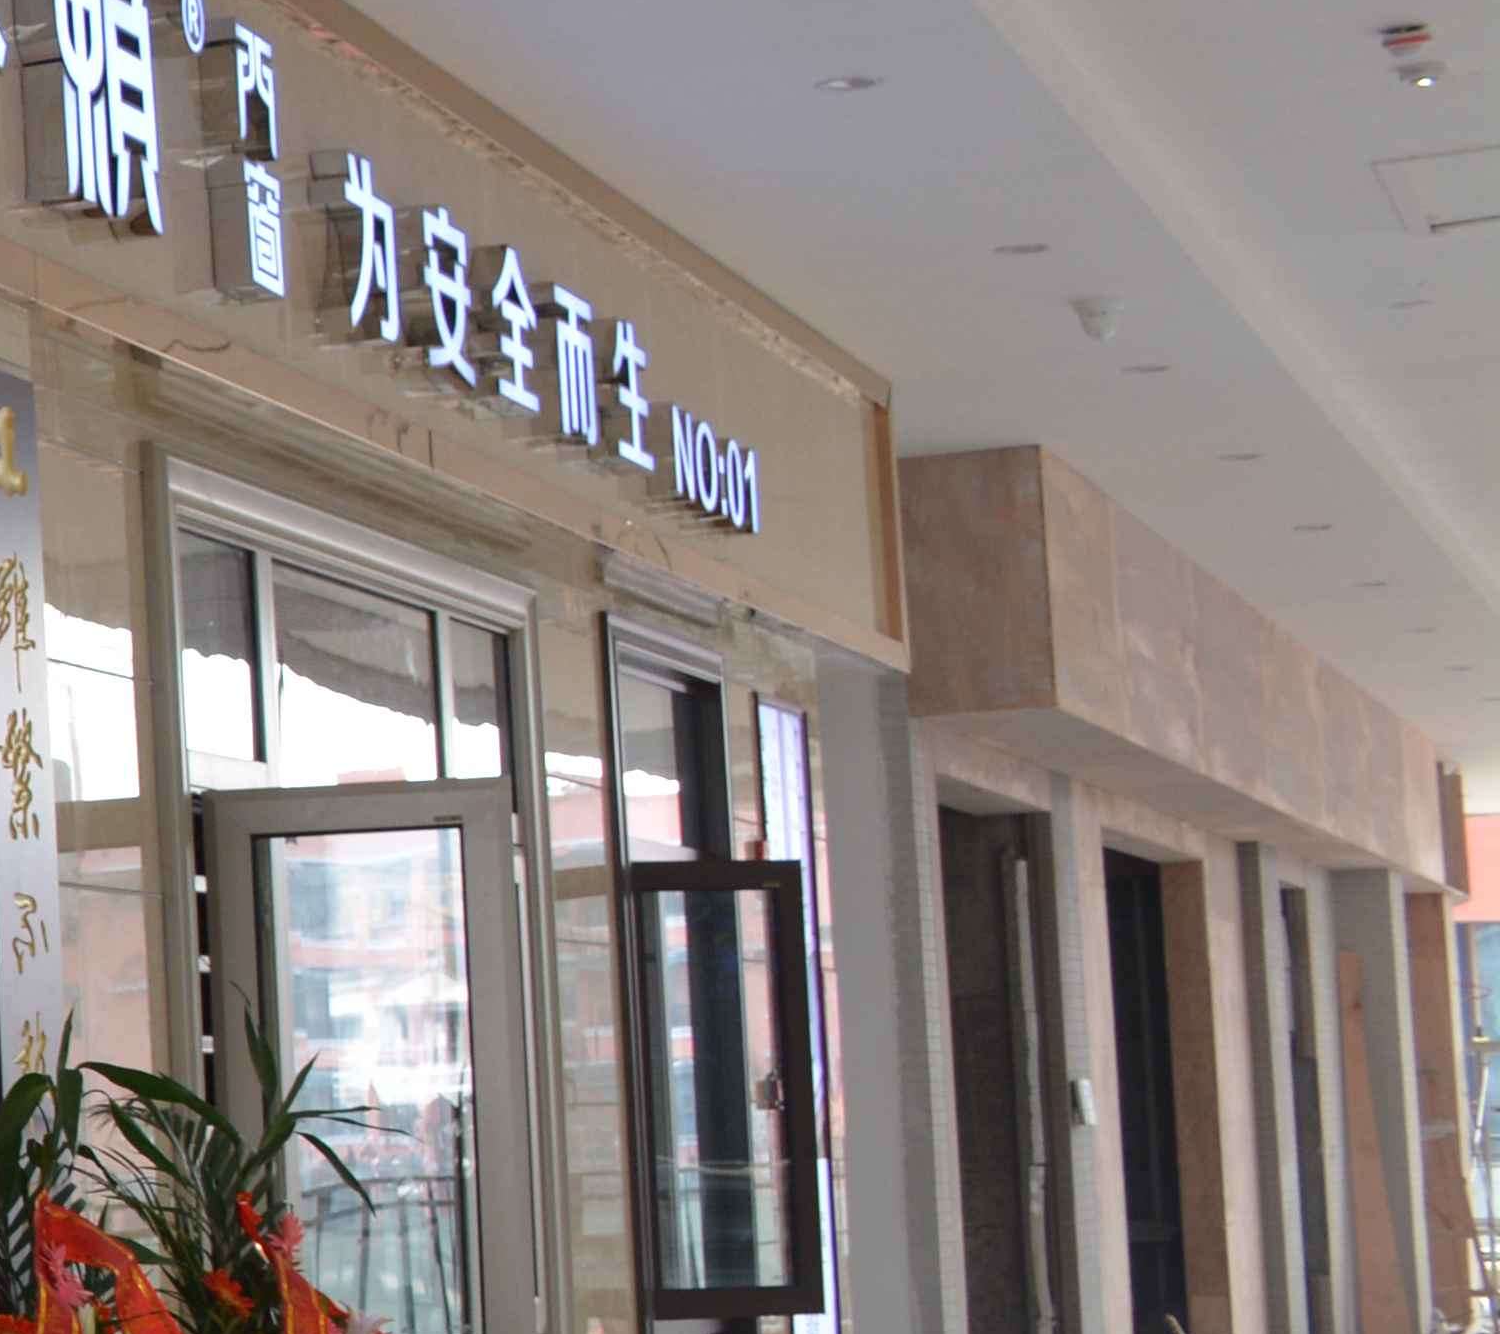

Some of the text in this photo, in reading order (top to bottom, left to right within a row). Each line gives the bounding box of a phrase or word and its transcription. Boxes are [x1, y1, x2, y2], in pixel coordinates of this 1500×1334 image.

[343, 152, 761, 535] 为安全而生 NO:01
